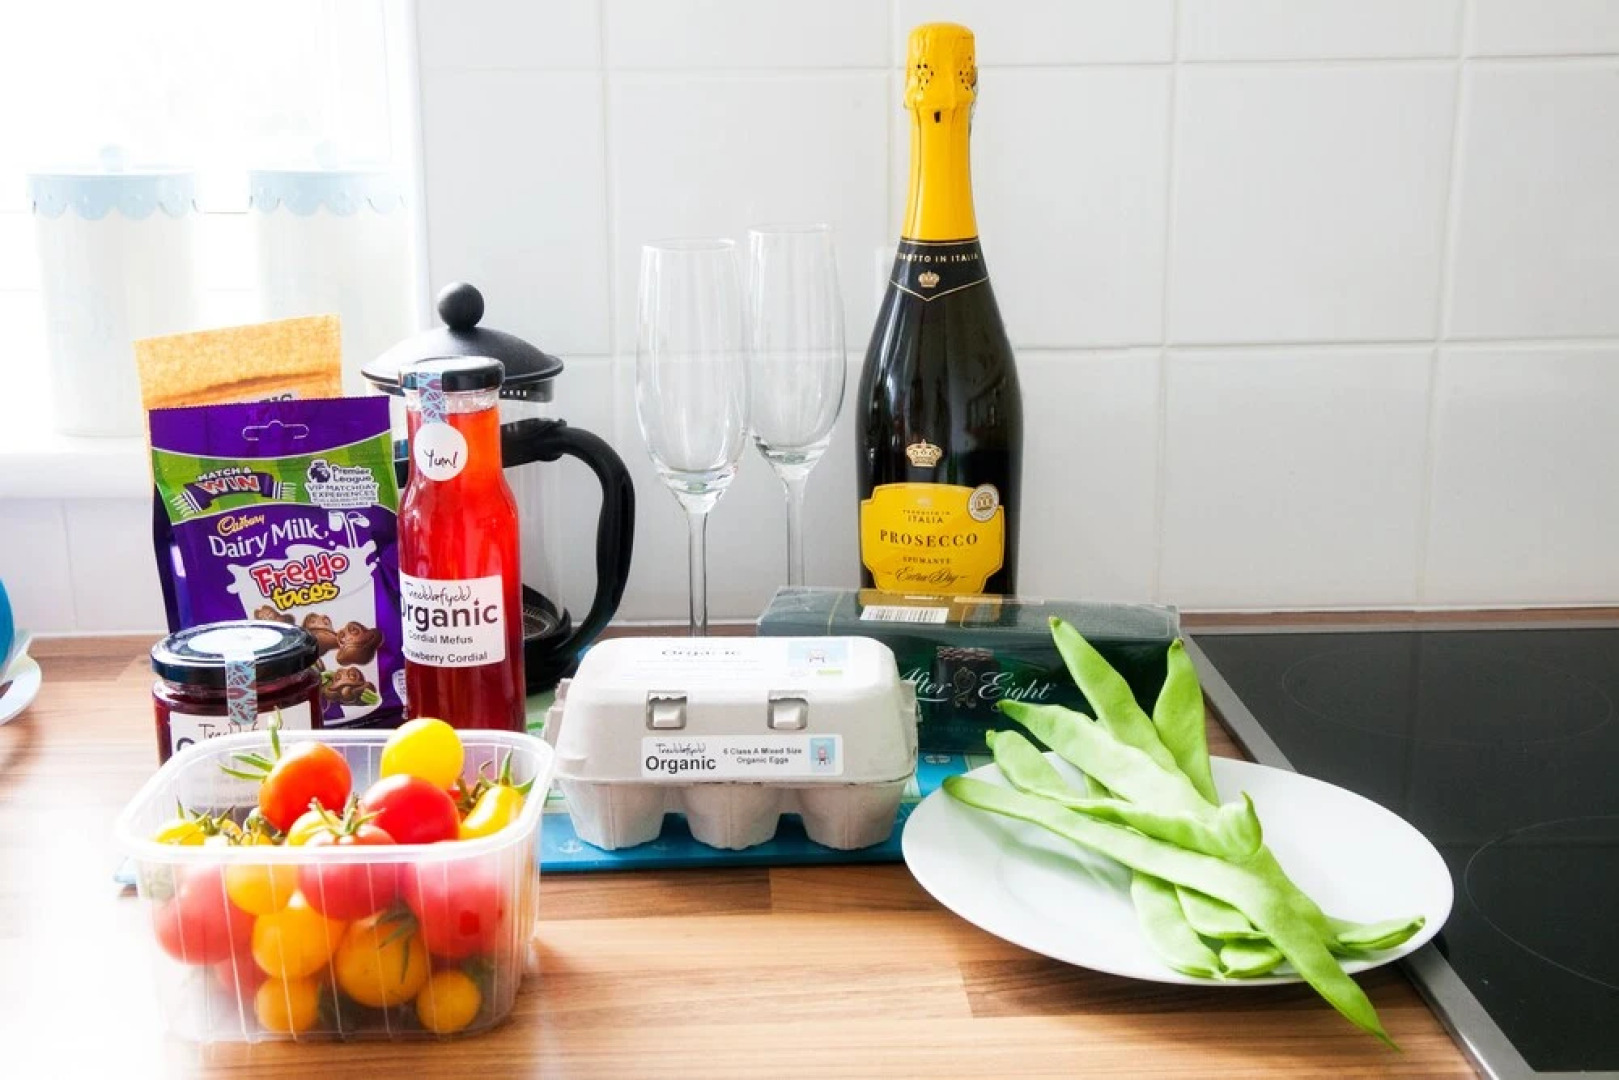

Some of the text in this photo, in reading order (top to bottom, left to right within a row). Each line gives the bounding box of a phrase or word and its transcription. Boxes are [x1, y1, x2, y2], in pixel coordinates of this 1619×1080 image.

[935, 255, 947, 263] IN
[423, 448, 459, 468] Yum!
[331, 465, 370, 474] Premier
[332, 474, 373, 484] League
[194, 474, 260, 495] WIN
[217, 514, 265, 536] Cadbury
[907, 515, 944, 524] ITALIA
[208, 517, 329, 558] Dairy Milk
[879, 529, 979, 548] PROSECCO
[249, 552, 348, 597] Freddo
[271, 580, 341, 610] faces
[439, 635, 474, 645] Mefus
[446, 650, 488, 663] Cordial
[978, 671, 1054, 701] Eight
[723, 747, 802, 756] 6 Class A Mixed Size
[736, 756, 789, 765] Organic Eggs
[645, 755, 717, 775] Organic
